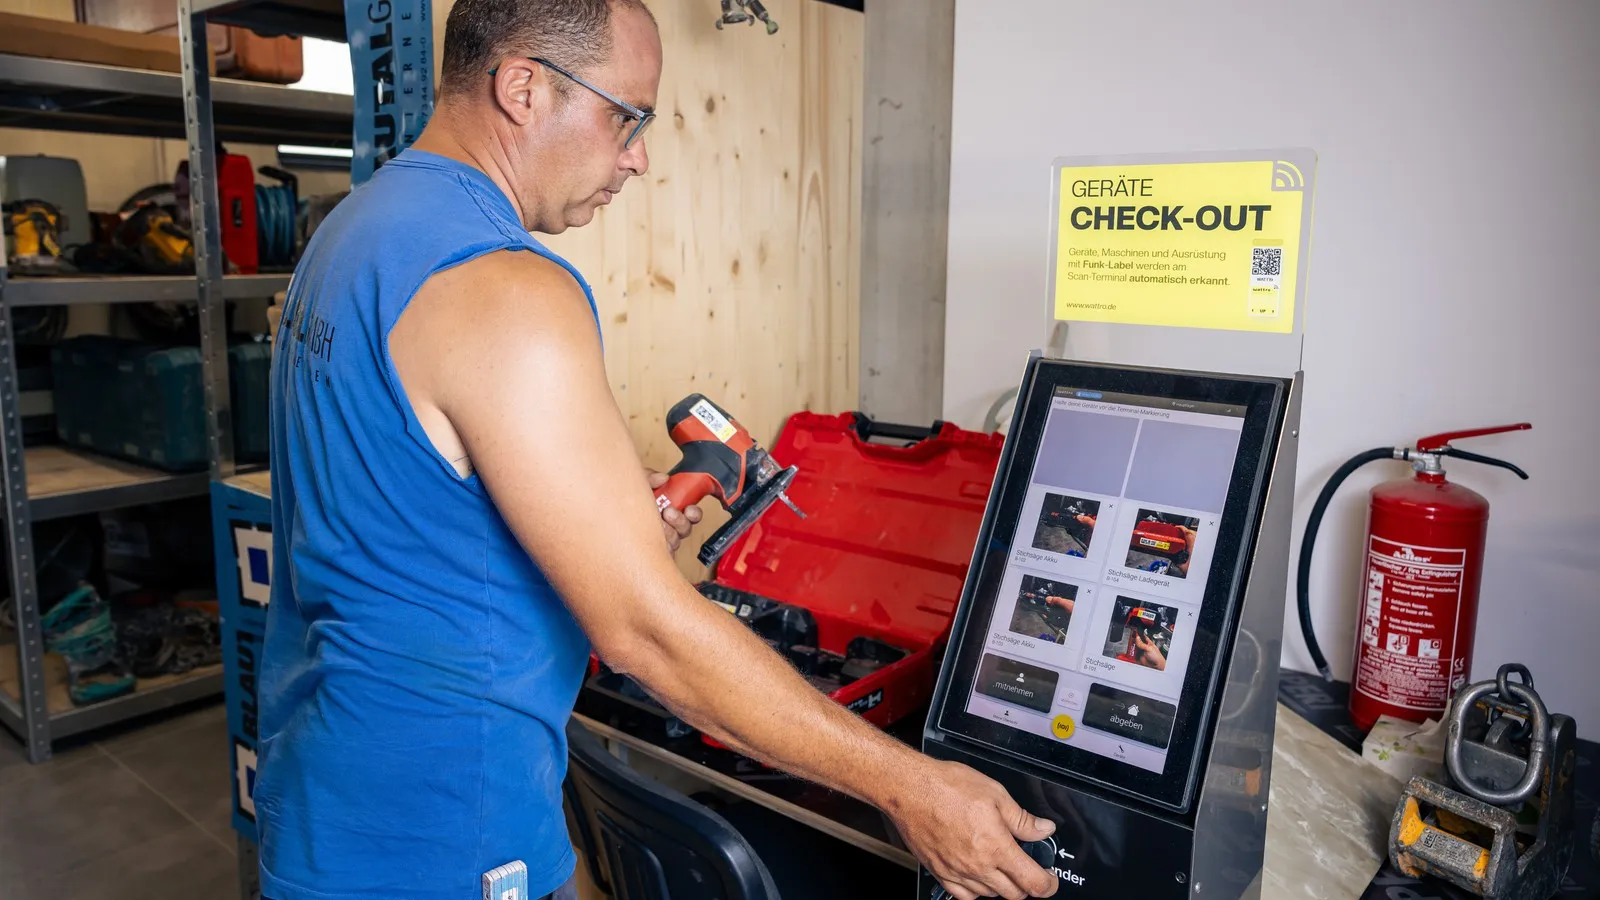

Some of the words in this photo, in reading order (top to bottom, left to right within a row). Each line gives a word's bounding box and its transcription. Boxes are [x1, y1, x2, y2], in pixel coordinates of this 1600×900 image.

[1071, 175, 1154, 198] GERÄTE
[1070, 205, 1272, 231] CHECK-OUT
[1068, 247, 1100, 258] Geräte,
[1101, 248, 1149, 258] Maschinen
[1151, 249, 1169, 258] und
[1171, 249, 1226, 260] Ausrüstung
[1068, 260, 1081, 269] mit
[1083, 260, 1134, 270] Funk-Label
[1136, 262, 1170, 271] werden
[1067, 272, 1127, 282] Scan-Terminal
[1129, 274, 1187, 284] automatisch
[1189, 275, 1230, 286] erkannt.
[1066, 301, 1117, 310] www.wattro.de
[1082, 402, 1098, 410] Geräte
[1117, 407, 1170, 418] Terminal-Markierung
[1016, 549, 1043, 561] Stichsäge
[1044, 556, 1058, 564] Akku
[1393, 548, 1430, 562] Adler
[1108, 568, 1138, 581] Stichsäge
[1139, 574, 1170, 588] Ladegerät
[1421, 569, 1458, 578] Extinguisher
[992, 632, 1021, 645] Stichsäge
[1021, 640, 1035, 649] Akku
[1432, 640, 1439, 648] C
[1085, 657, 1116, 670] Stichsäge
[995, 681, 1034, 698] mitnehmen
[1109, 714, 1143, 731] abgeben
[1051, 866, 1085, 886] nder
